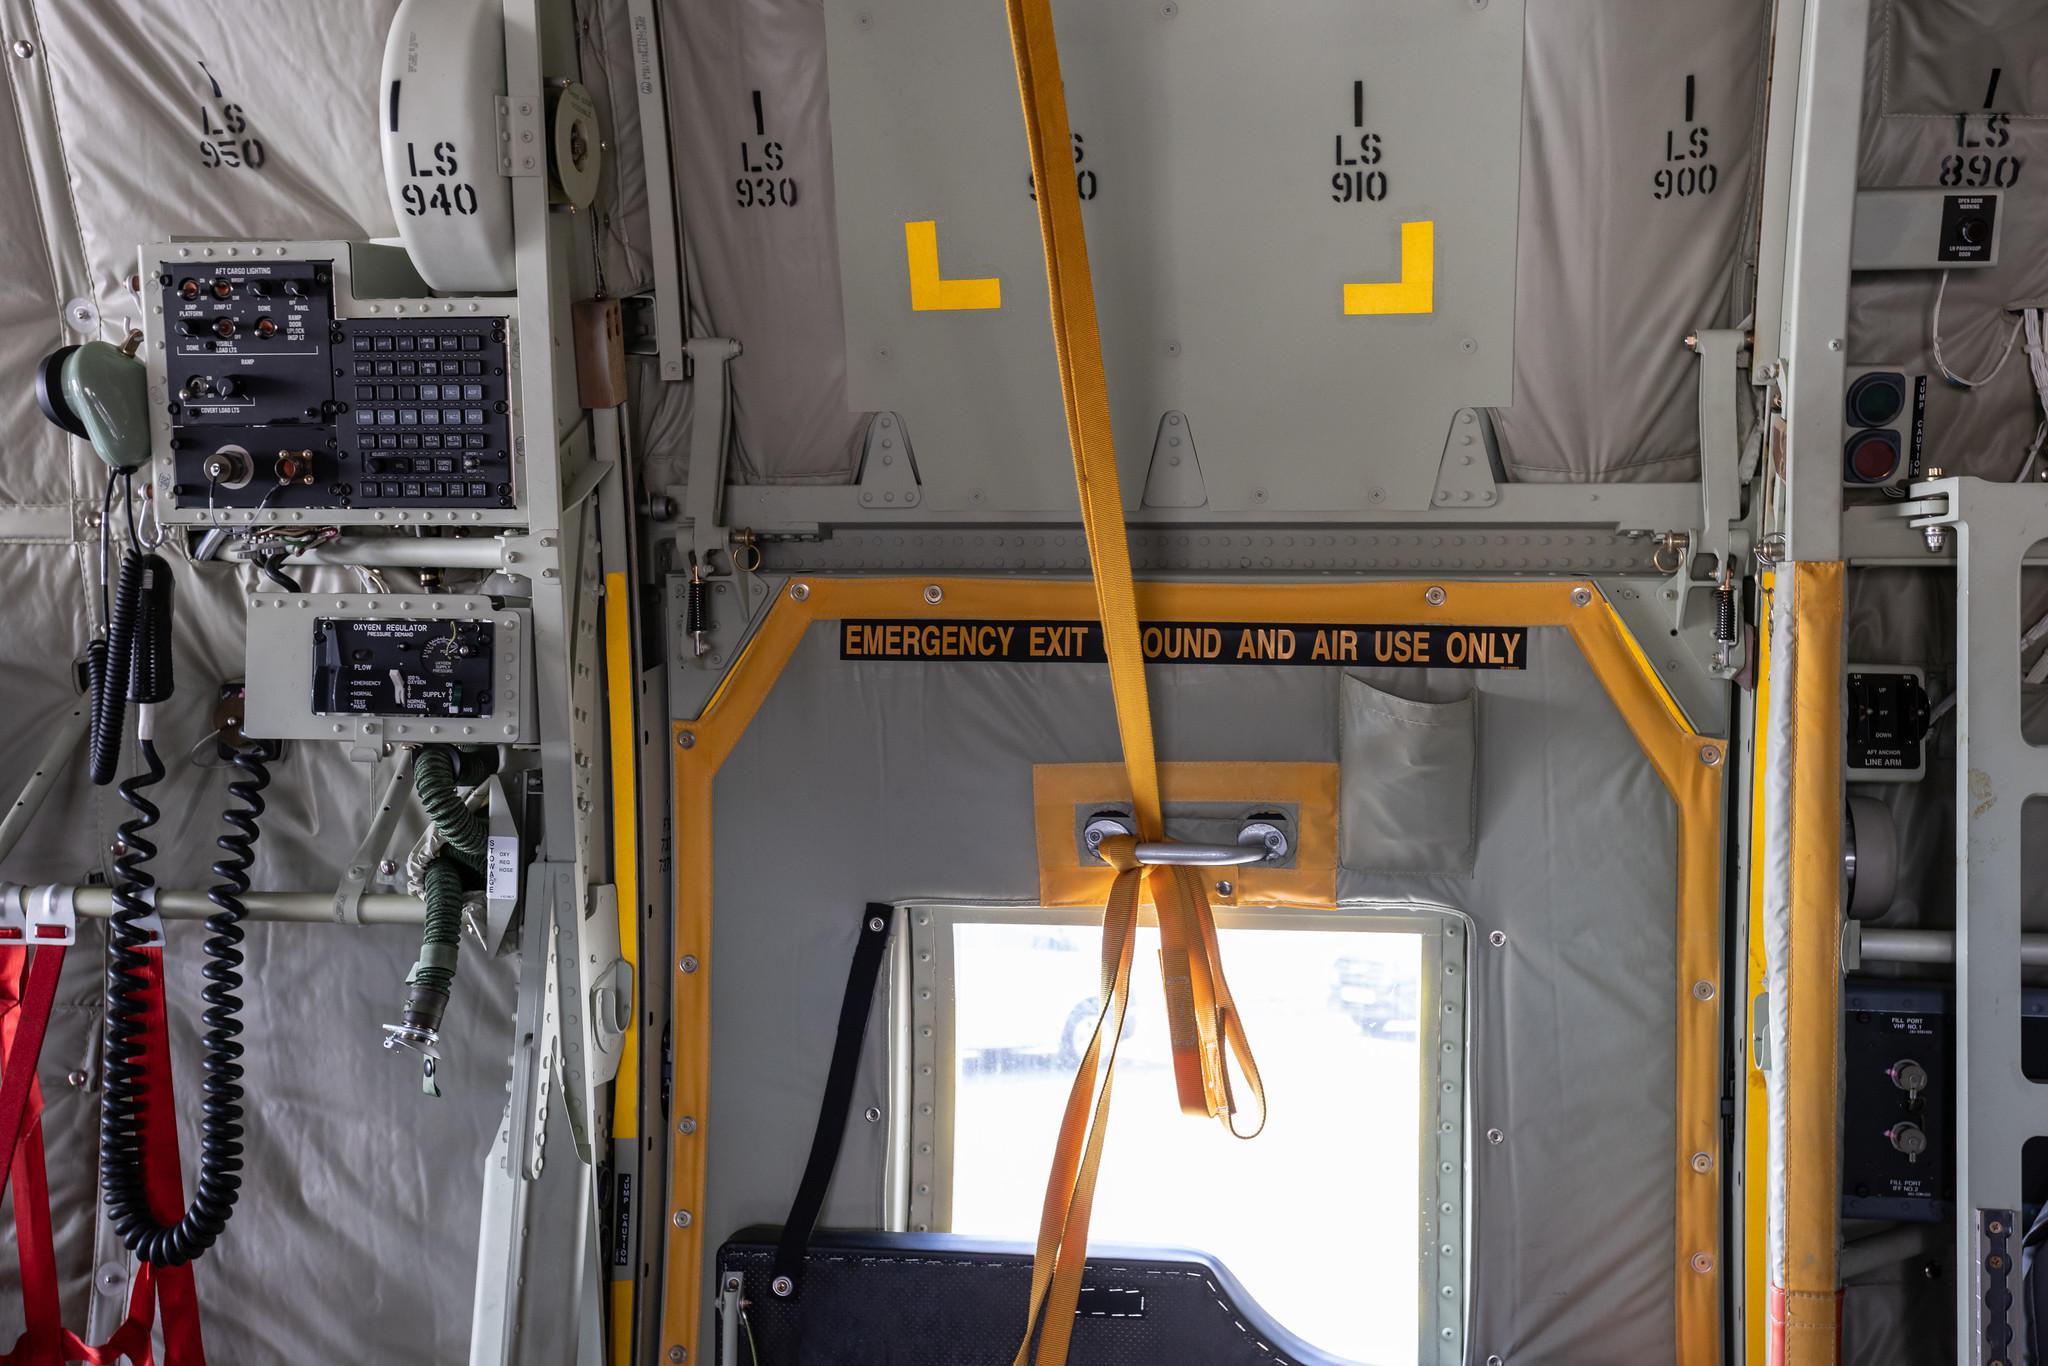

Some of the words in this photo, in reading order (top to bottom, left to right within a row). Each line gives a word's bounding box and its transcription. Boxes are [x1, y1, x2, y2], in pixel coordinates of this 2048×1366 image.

[201, 104, 246, 136] LS
[1956, 112, 2011, 148] LS
[200, 138, 265, 169] 950
[407, 142, 458, 177] LS
[741, 141, 784, 172] LS
[1335, 133, 1382, 166] LS
[1666, 127, 1709, 162] LS
[1331, 171, 1387, 203] 910
[1653, 164, 1717, 200] 900
[1939, 155, 2020, 189] 890
[401, 183, 478, 216] 940
[736, 177, 798, 208] 930
[1918, 378, 1927, 409] JUMP
[1913, 420, 1924, 475] CAUTION
[353, 624, 382, 632] OXYGEN
[386, 624, 428, 632] REGULATOR
[846, 625, 1015, 657] EMERGENCY
[1030, 626, 1089, 657] EXIT
[1103, 627, 1221, 659] OUND
[1236, 629, 1296, 660] AND
[1311, 630, 1358, 661] AIR
[1375, 631, 1430, 663] USE
[1446, 632, 1521, 664] ONLY
[620, 1213, 629, 1264] CAUTION
